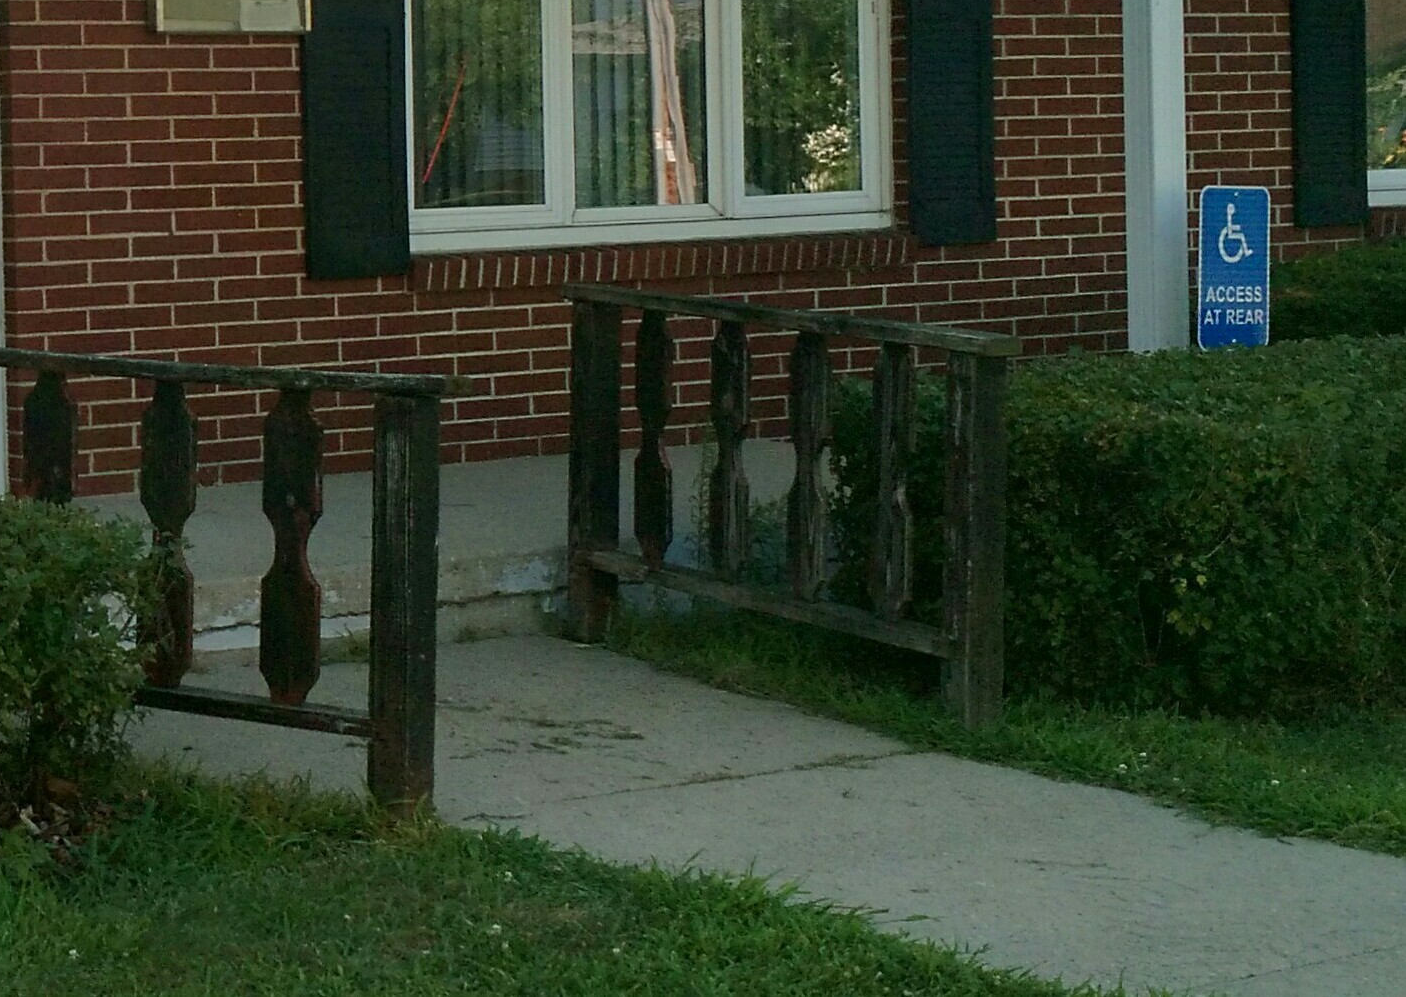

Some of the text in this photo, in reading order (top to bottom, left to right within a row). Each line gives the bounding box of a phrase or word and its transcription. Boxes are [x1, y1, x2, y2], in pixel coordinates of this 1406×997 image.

[1205, 285, 1263, 303] ACCESS
[1203, 308, 1265, 326] AT REAR
